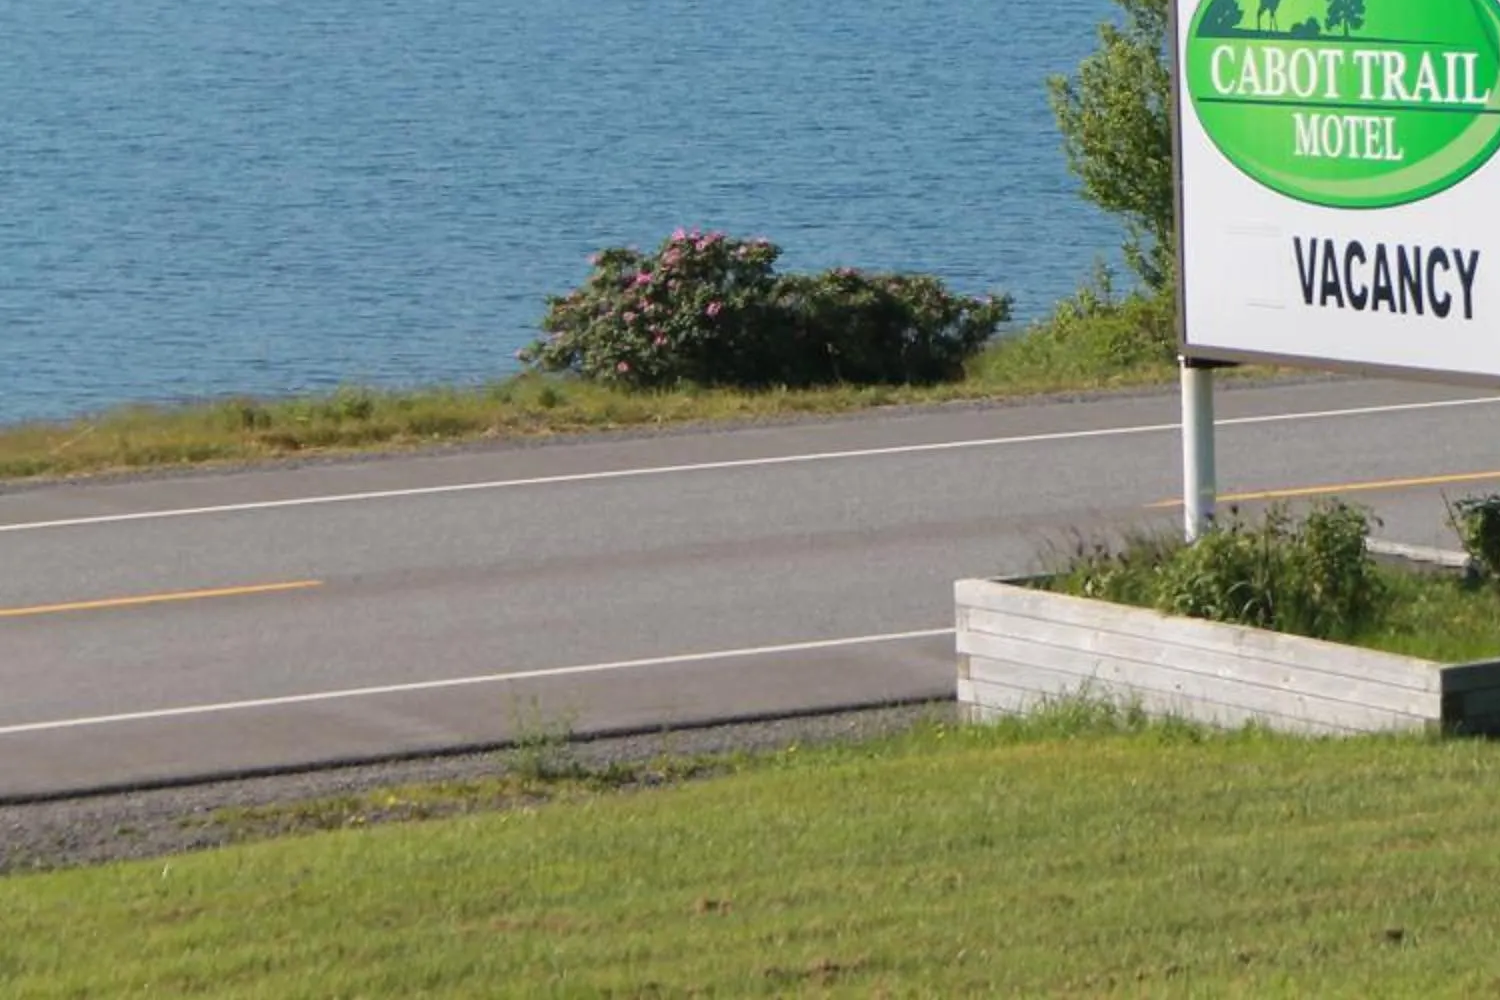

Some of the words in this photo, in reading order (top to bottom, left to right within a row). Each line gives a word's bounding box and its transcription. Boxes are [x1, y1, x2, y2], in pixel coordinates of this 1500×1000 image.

[1210, 45, 1344, 98] CABOT
[1353, 49, 1491, 104] TRAIL
[1292, 112, 1404, 161] MOTEL
[1293, 236, 1480, 320] VACANCY
